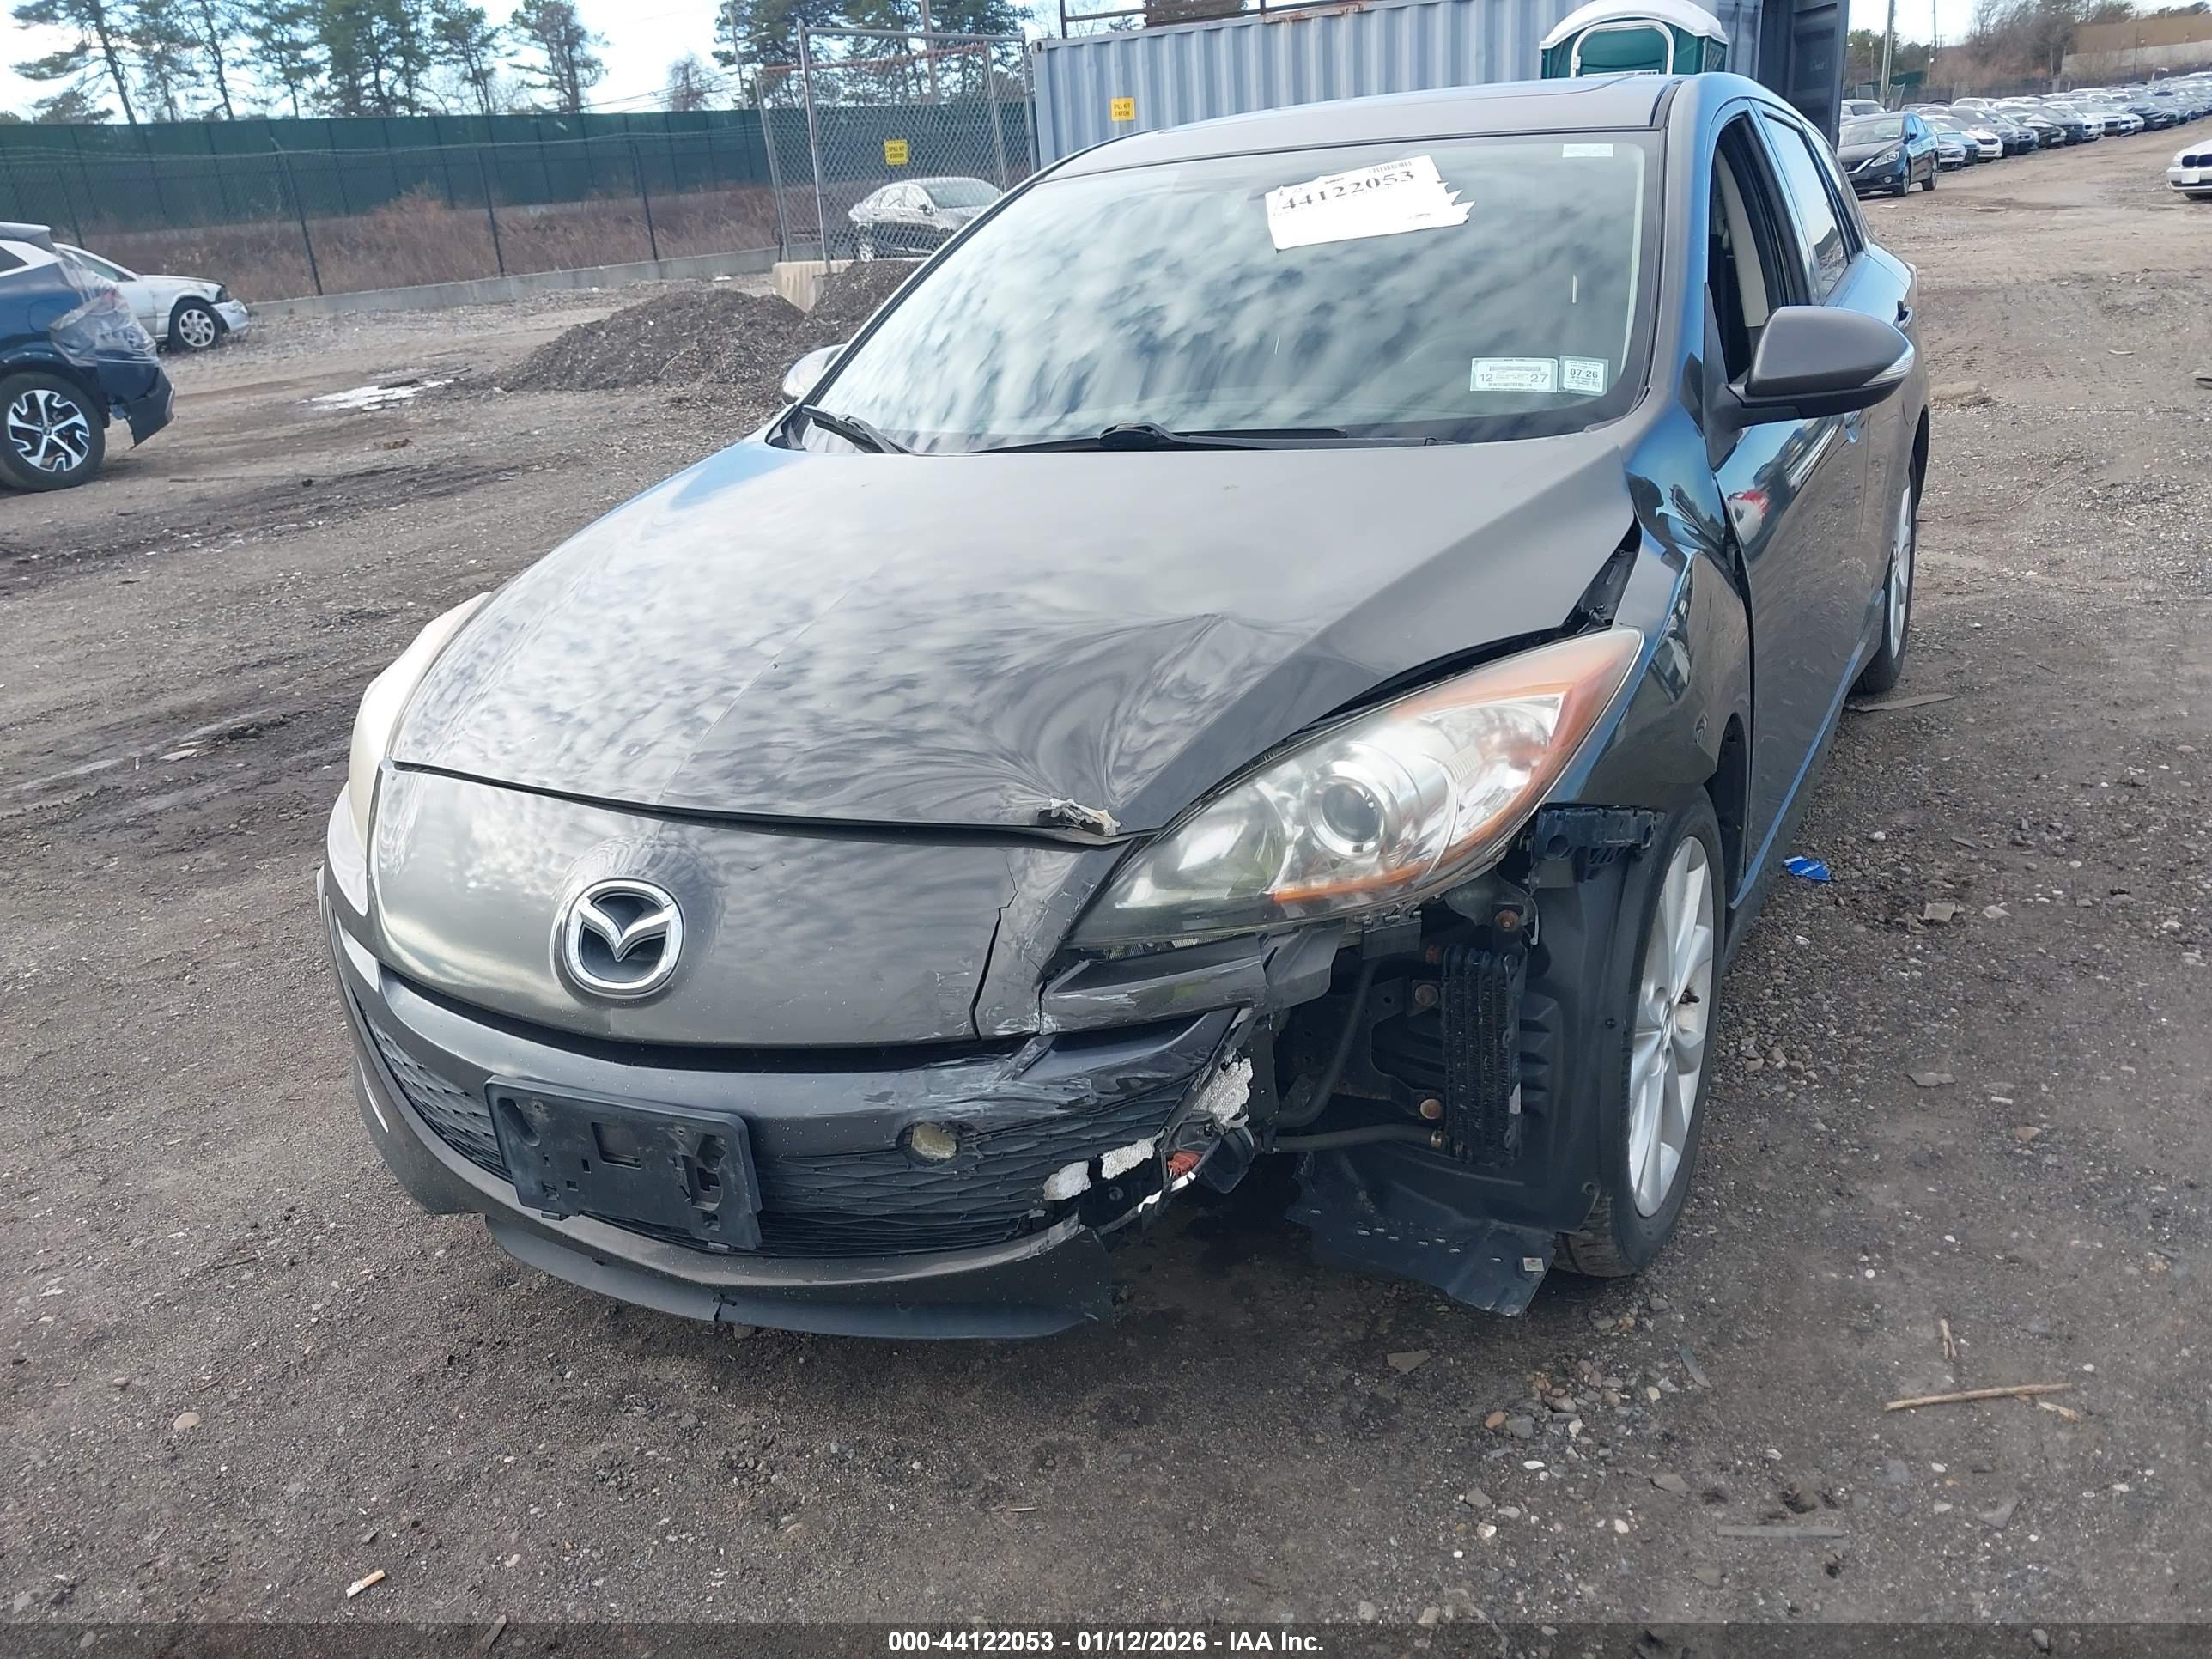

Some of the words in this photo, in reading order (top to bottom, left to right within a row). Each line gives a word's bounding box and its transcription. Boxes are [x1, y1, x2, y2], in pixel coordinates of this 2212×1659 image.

[1281, 170, 1414, 210] 44122053
[1480, 374, 1493, 383] 12
[1530, 374, 1548, 383] 27
[1585, 369, 1599, 379] 26
